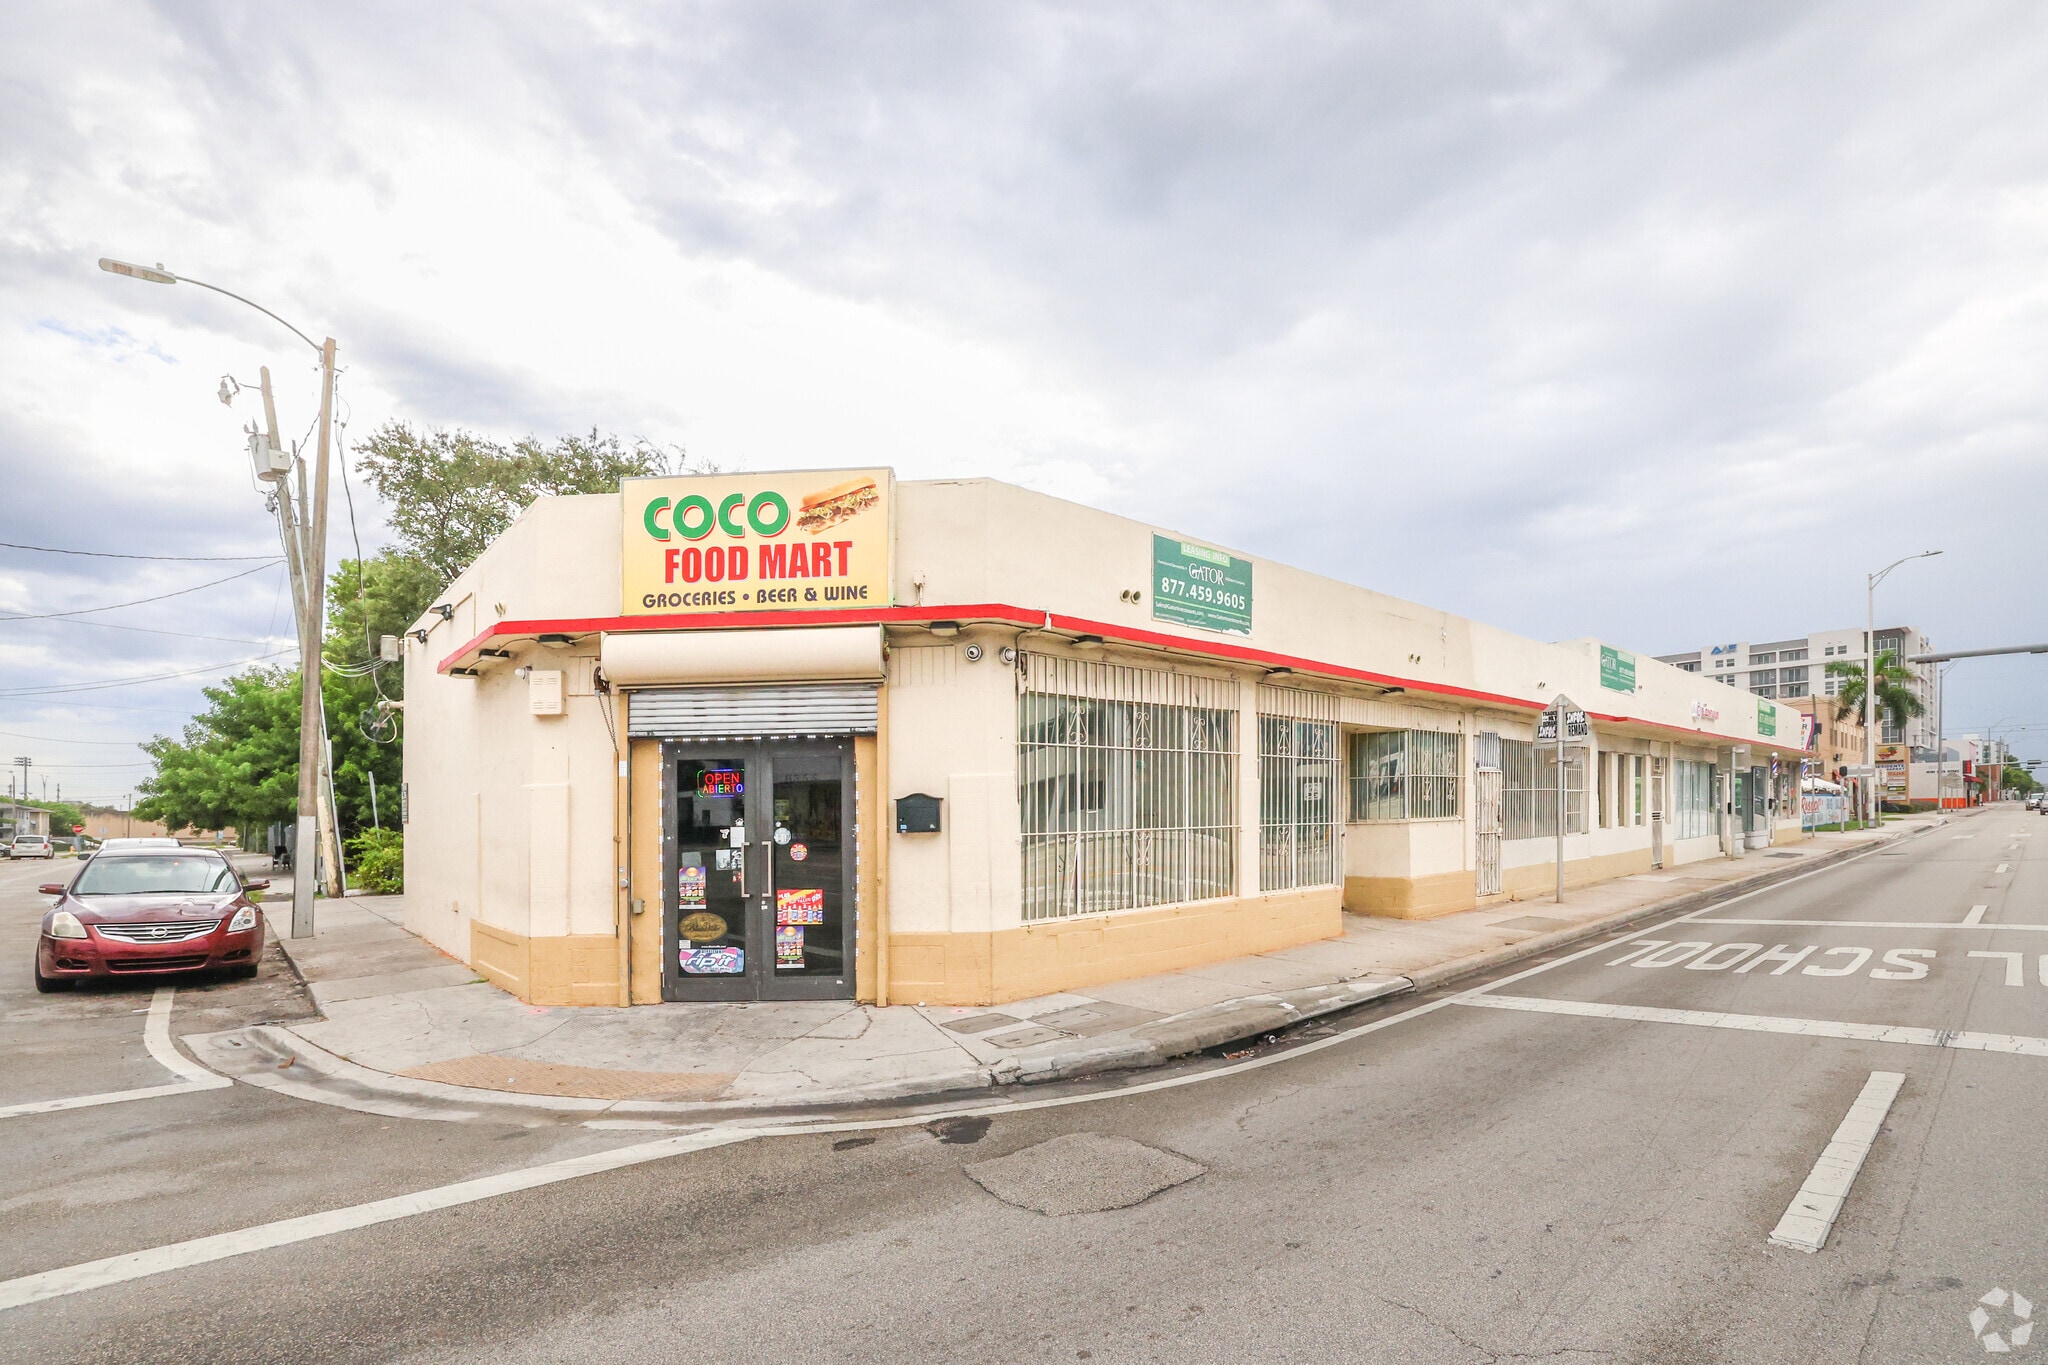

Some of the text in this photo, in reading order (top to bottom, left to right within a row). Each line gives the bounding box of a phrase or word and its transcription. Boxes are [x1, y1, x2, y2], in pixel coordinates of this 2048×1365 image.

[644, 491, 790, 542] COCO
[664, 541, 853, 583] FOOD MART
[1182, 544, 1228, 563] LEASING INFO
[1188, 563, 1225, 586] GATOR
[642, 585, 868, 608] GROCERIES BEER & WINE
[1161, 577, 1246, 611] 877.459.9605
[702, 784, 744, 795] ABIERTO
[704, 773, 740, 785] OPEN
[1605, 940, 1937, 980] SCHOOL
